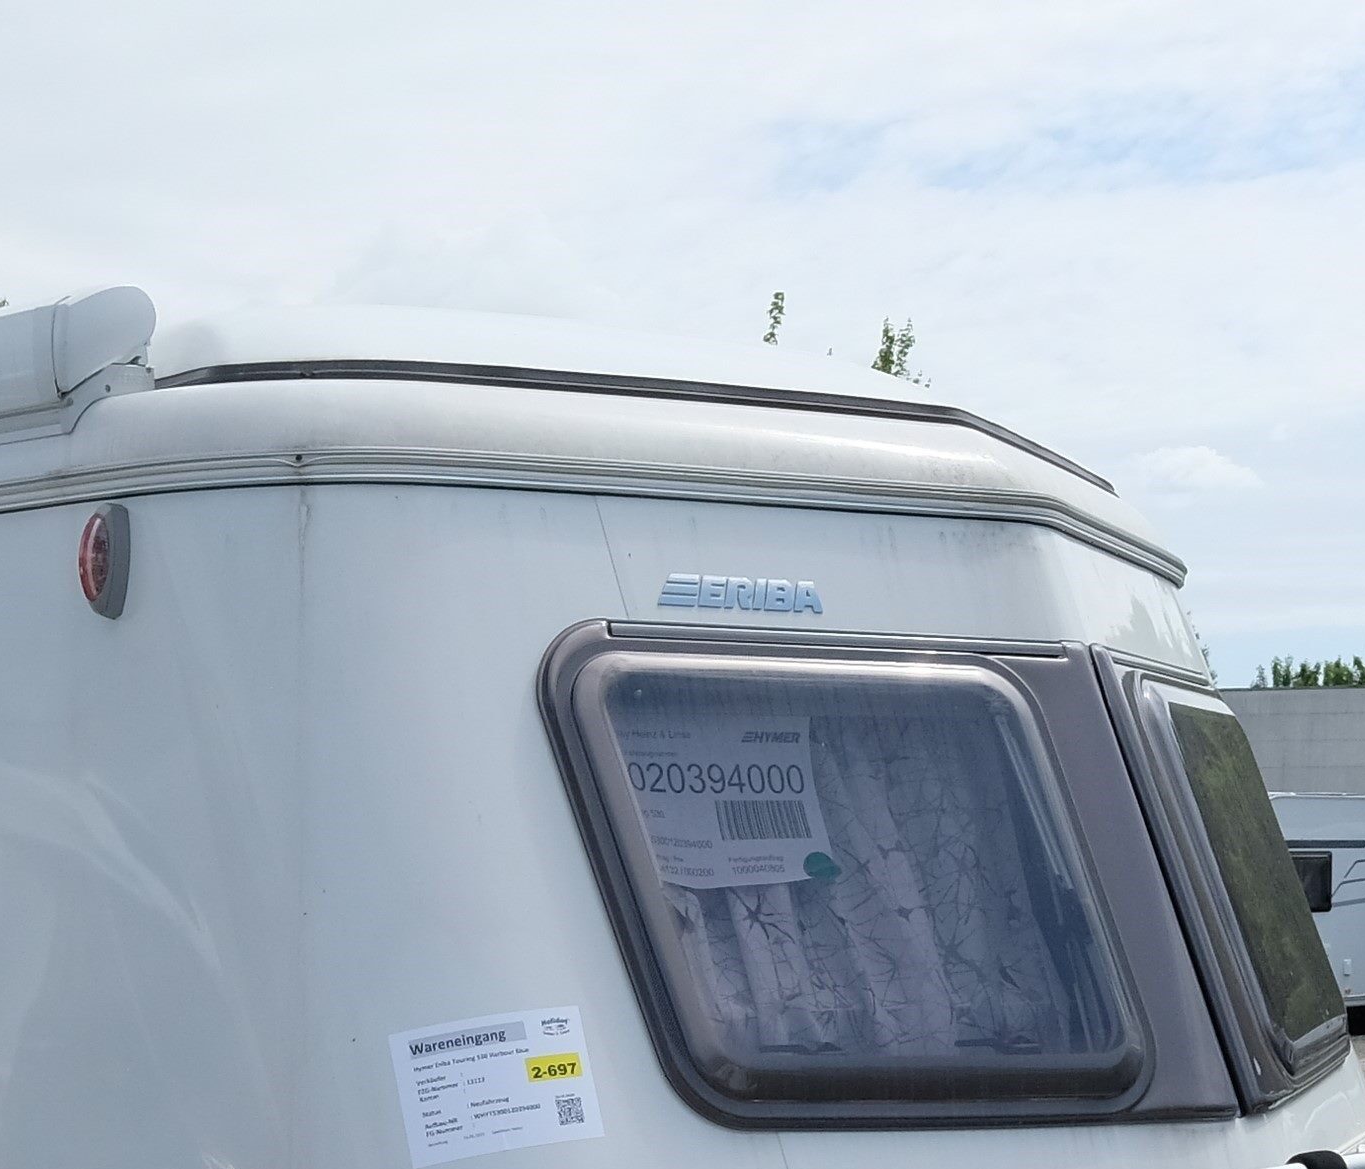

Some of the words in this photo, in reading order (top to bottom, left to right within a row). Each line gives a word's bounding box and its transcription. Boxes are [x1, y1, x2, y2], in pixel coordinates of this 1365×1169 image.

[658, 573, 823, 614] ERIBA
[628, 762, 805, 794] 020394000
[409, 1030, 507, 1056] Wareneingang
[531, 1062, 577, 1079] 2-697
